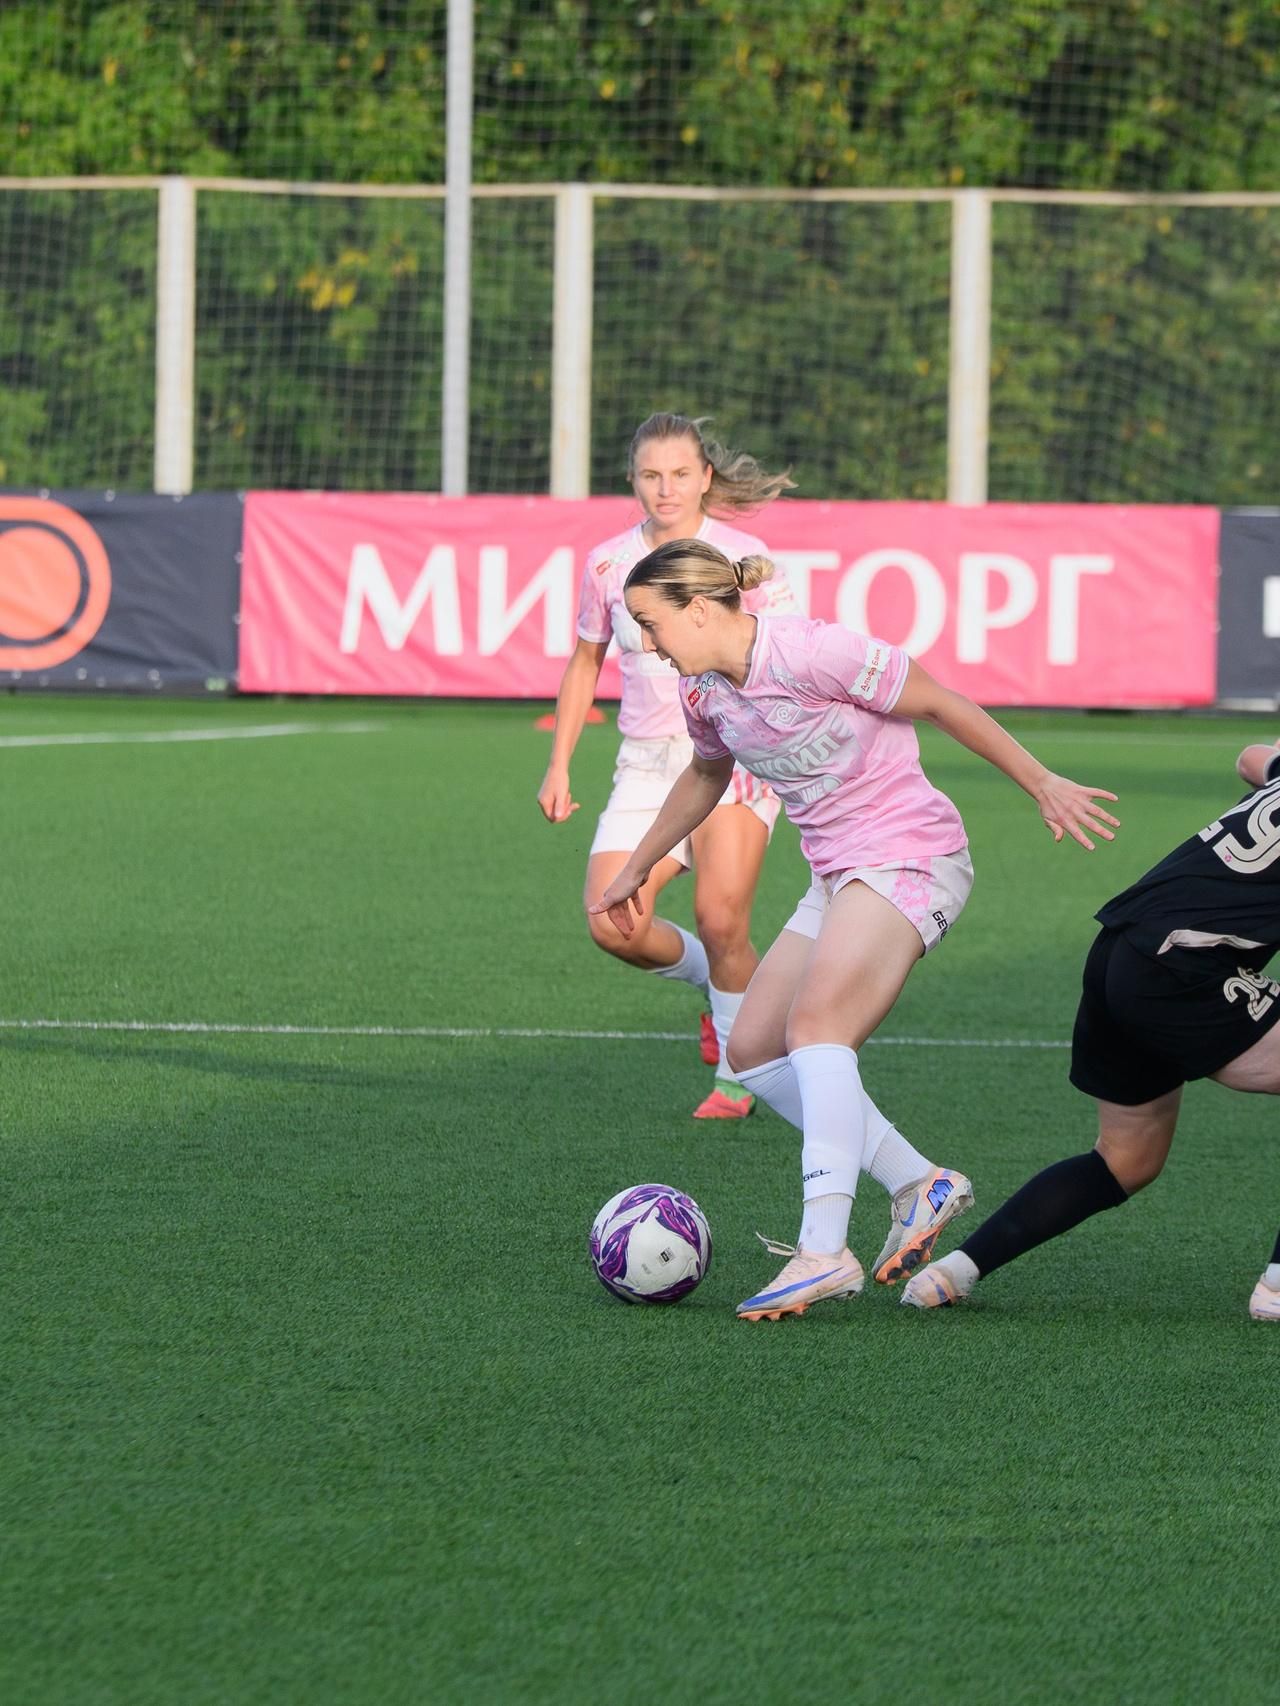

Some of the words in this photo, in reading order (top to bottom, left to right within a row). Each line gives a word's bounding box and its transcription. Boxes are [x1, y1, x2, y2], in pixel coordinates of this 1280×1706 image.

[339, 543, 1114, 665] МИТОРГ
[860, 667, 877, 692] Альфа
[746, 734, 840, 778] УКОЙЛ
[803, 1169, 831, 1182] GEL
